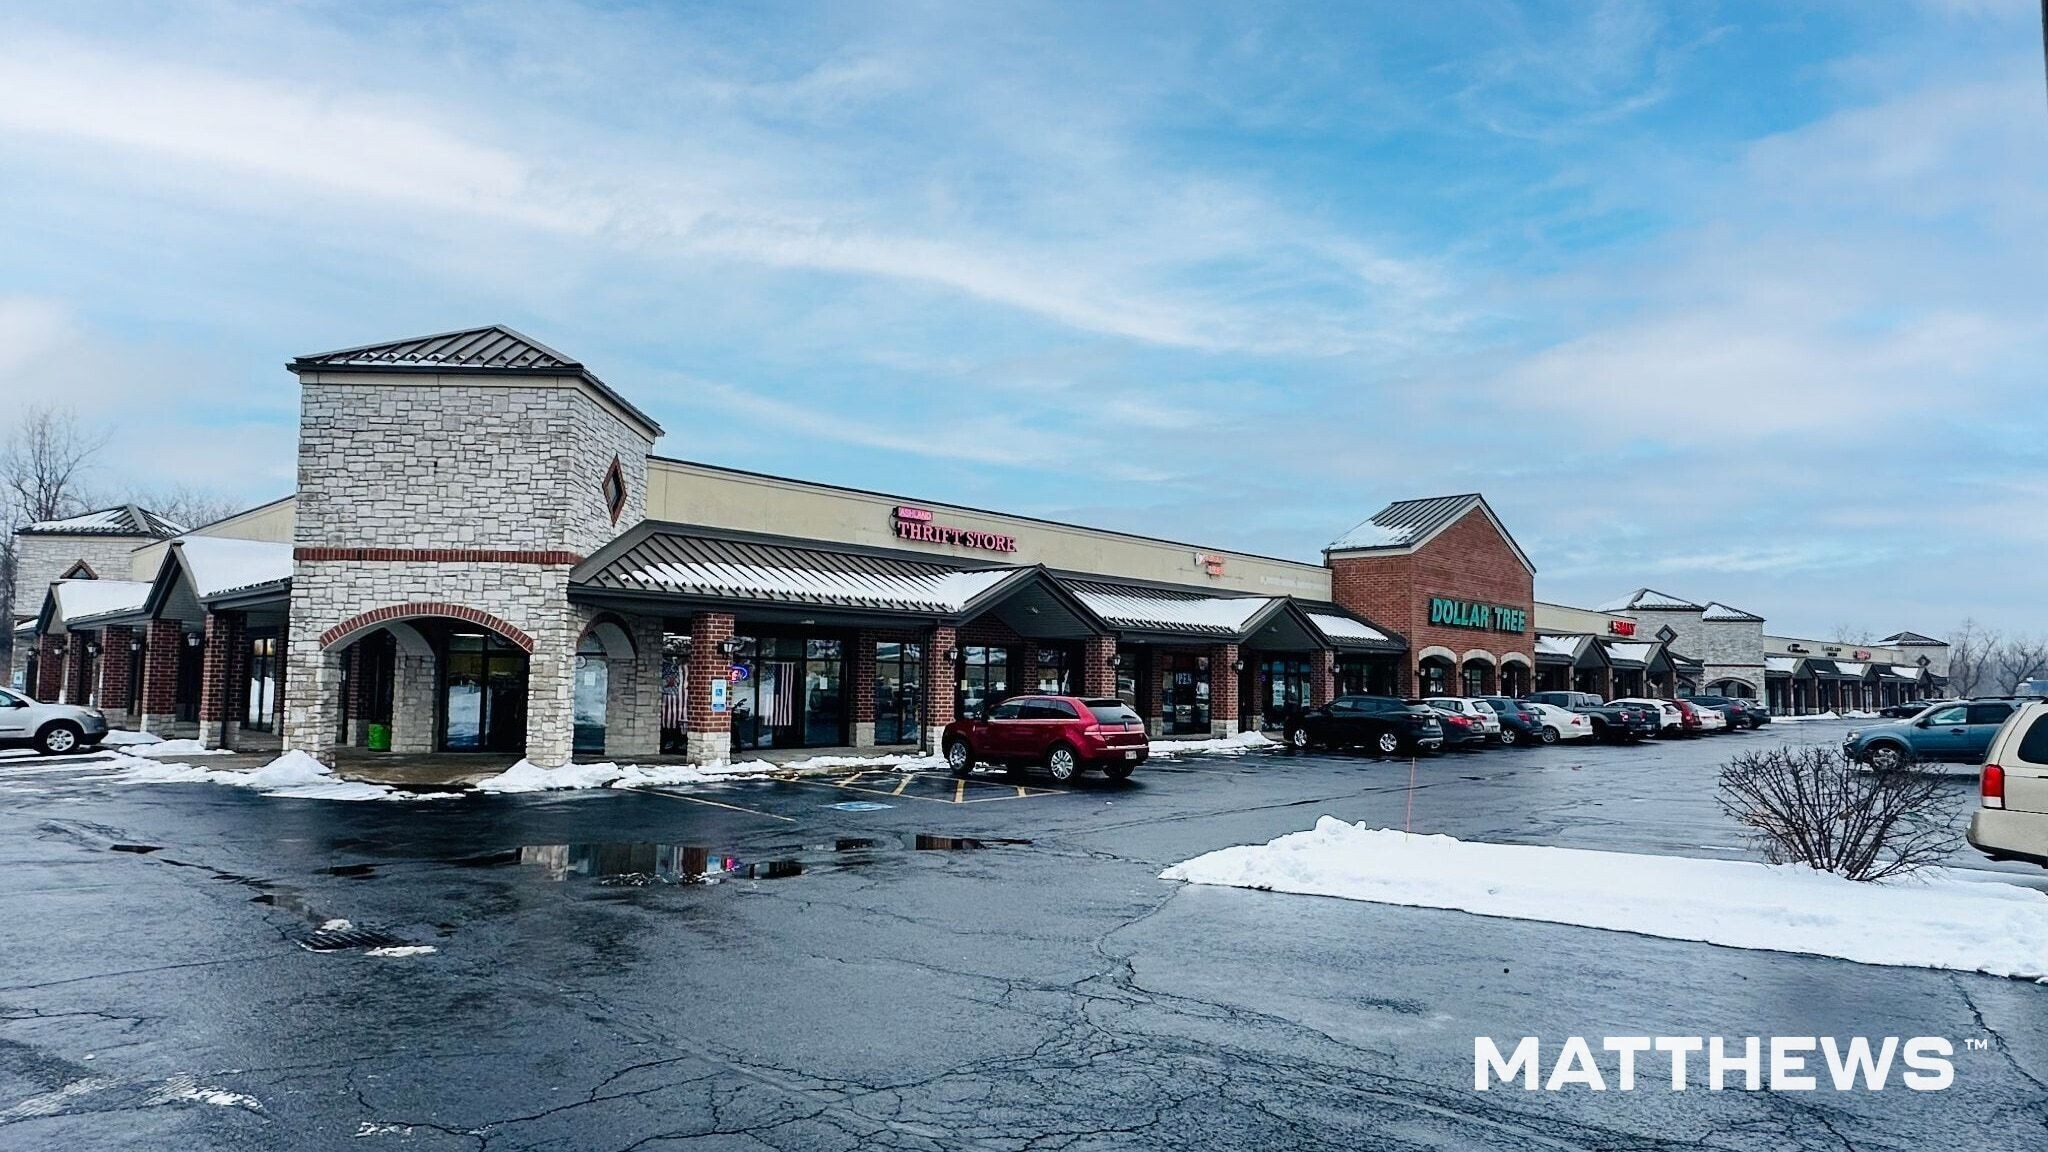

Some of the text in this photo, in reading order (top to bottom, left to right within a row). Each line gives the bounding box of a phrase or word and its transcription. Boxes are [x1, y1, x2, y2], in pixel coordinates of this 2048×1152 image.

[898, 521, 1017, 552] THRIFT STORE
[1431, 597, 1526, 632] DOLLAR TREE
